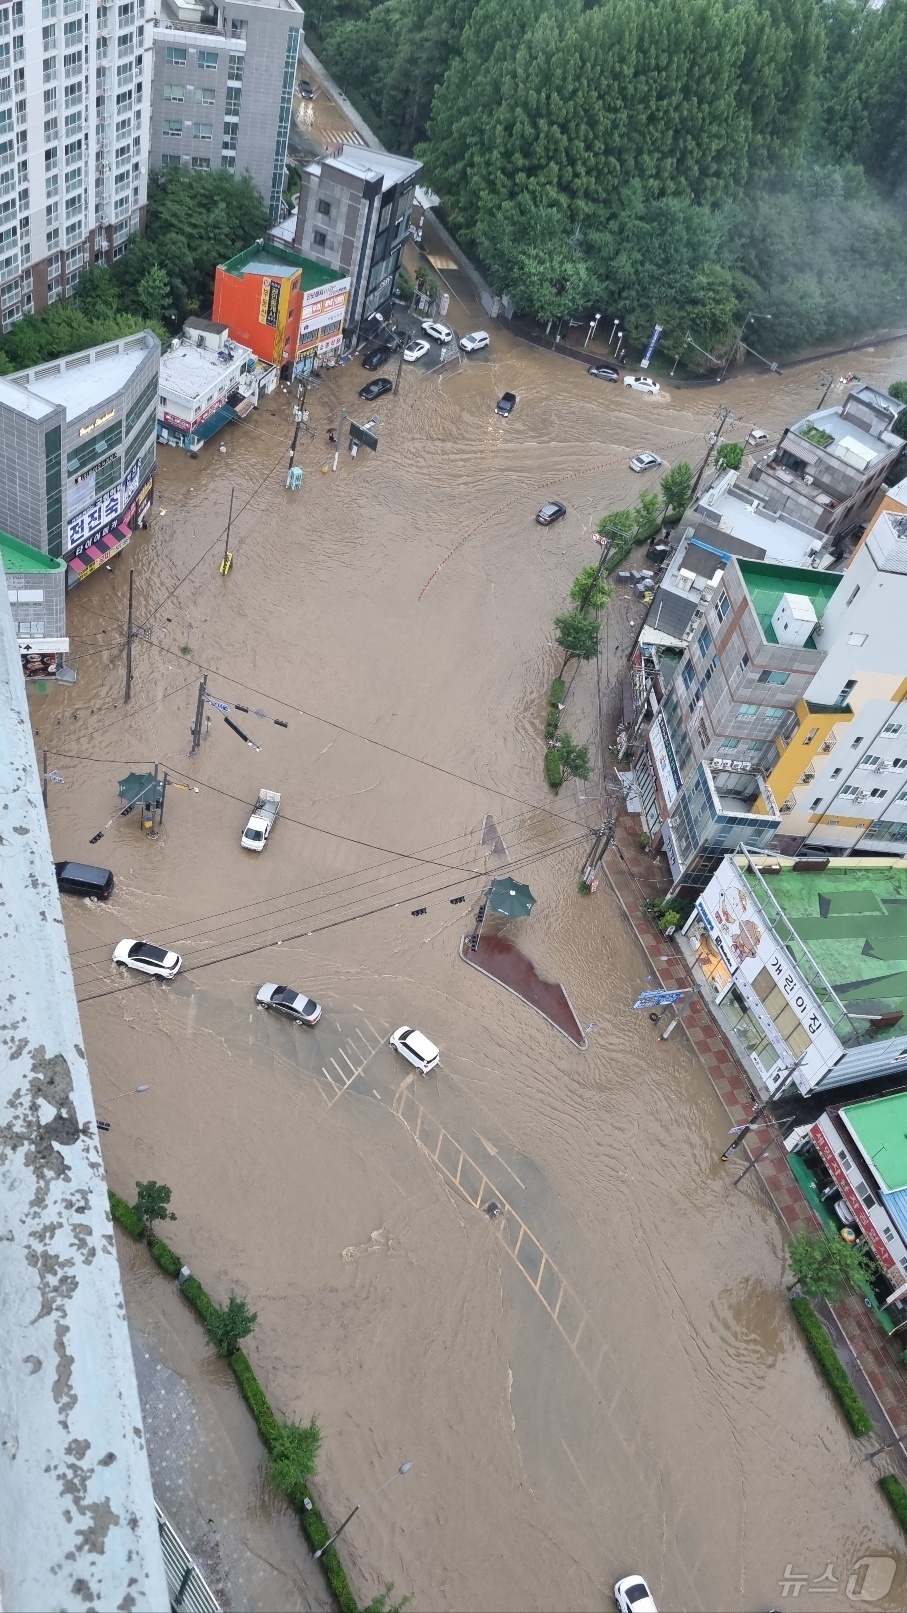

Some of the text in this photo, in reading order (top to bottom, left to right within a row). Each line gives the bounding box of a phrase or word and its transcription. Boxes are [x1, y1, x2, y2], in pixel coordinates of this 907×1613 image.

[261, 288, 269, 318] 부동산
[69, 496, 119, 547] 전진숙
[696, 902, 714, 932] PHILIPS
[771, 956, 822, 1035] 개린이집
